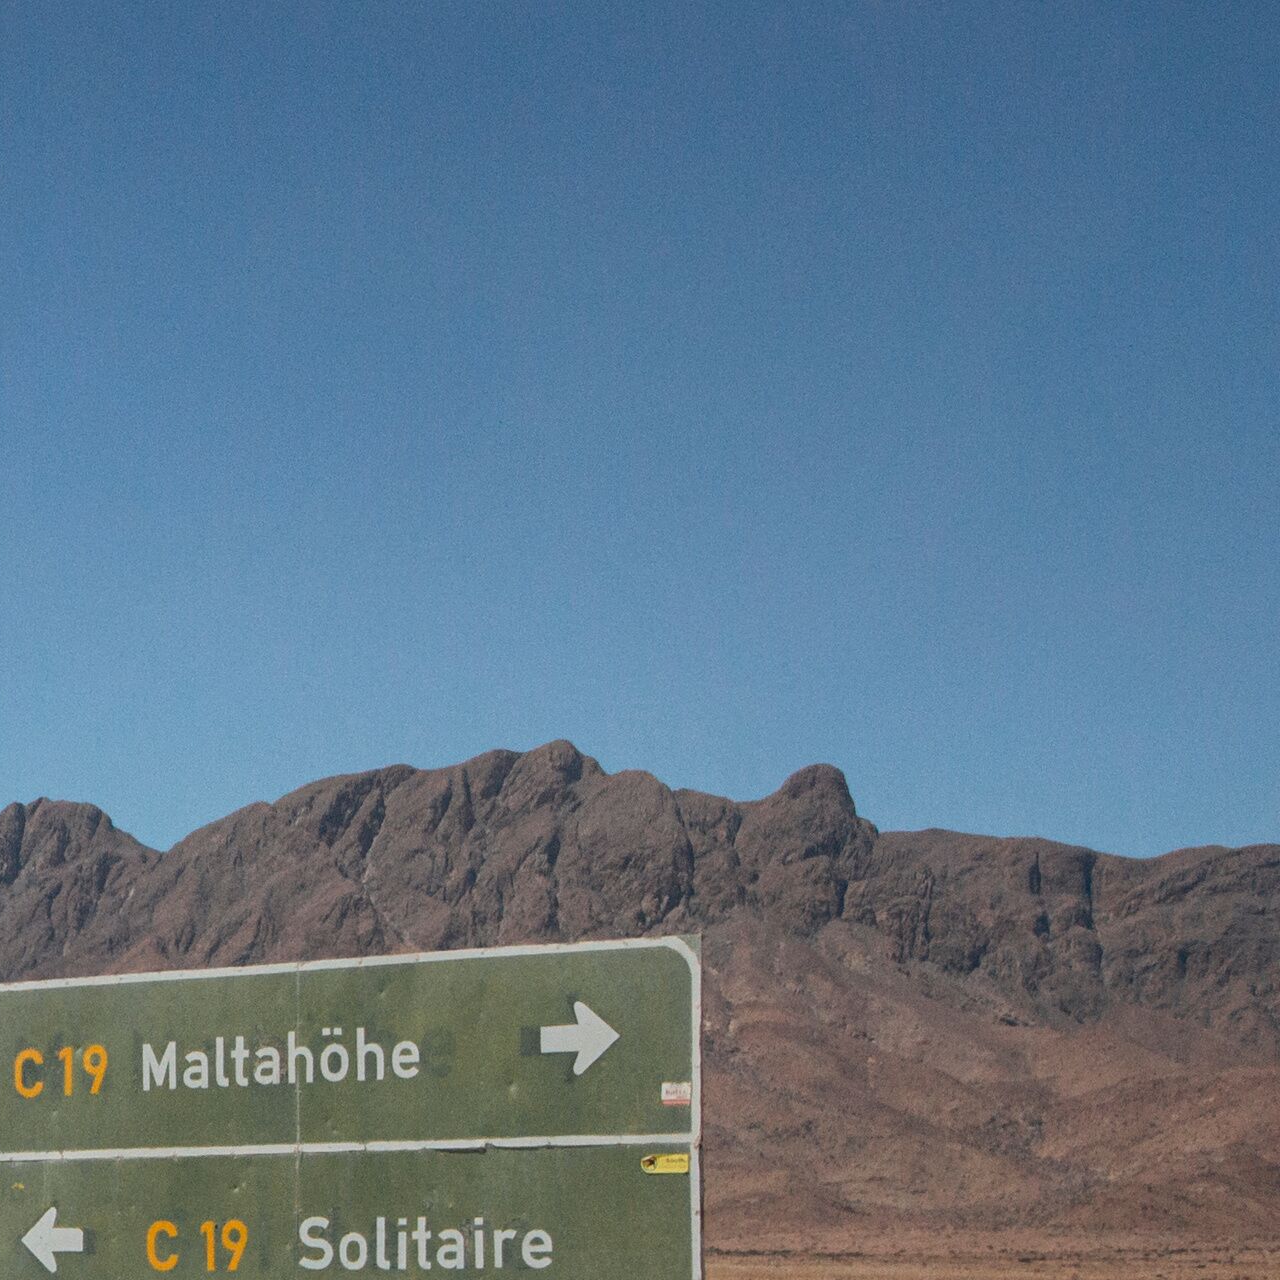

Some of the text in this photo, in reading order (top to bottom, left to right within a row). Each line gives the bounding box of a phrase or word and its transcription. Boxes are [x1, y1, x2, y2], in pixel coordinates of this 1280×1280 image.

[13, 1027, 421, 1098] C 19 Maltahöhe
[146, 1216, 554, 1272] C 19 Solitaire
